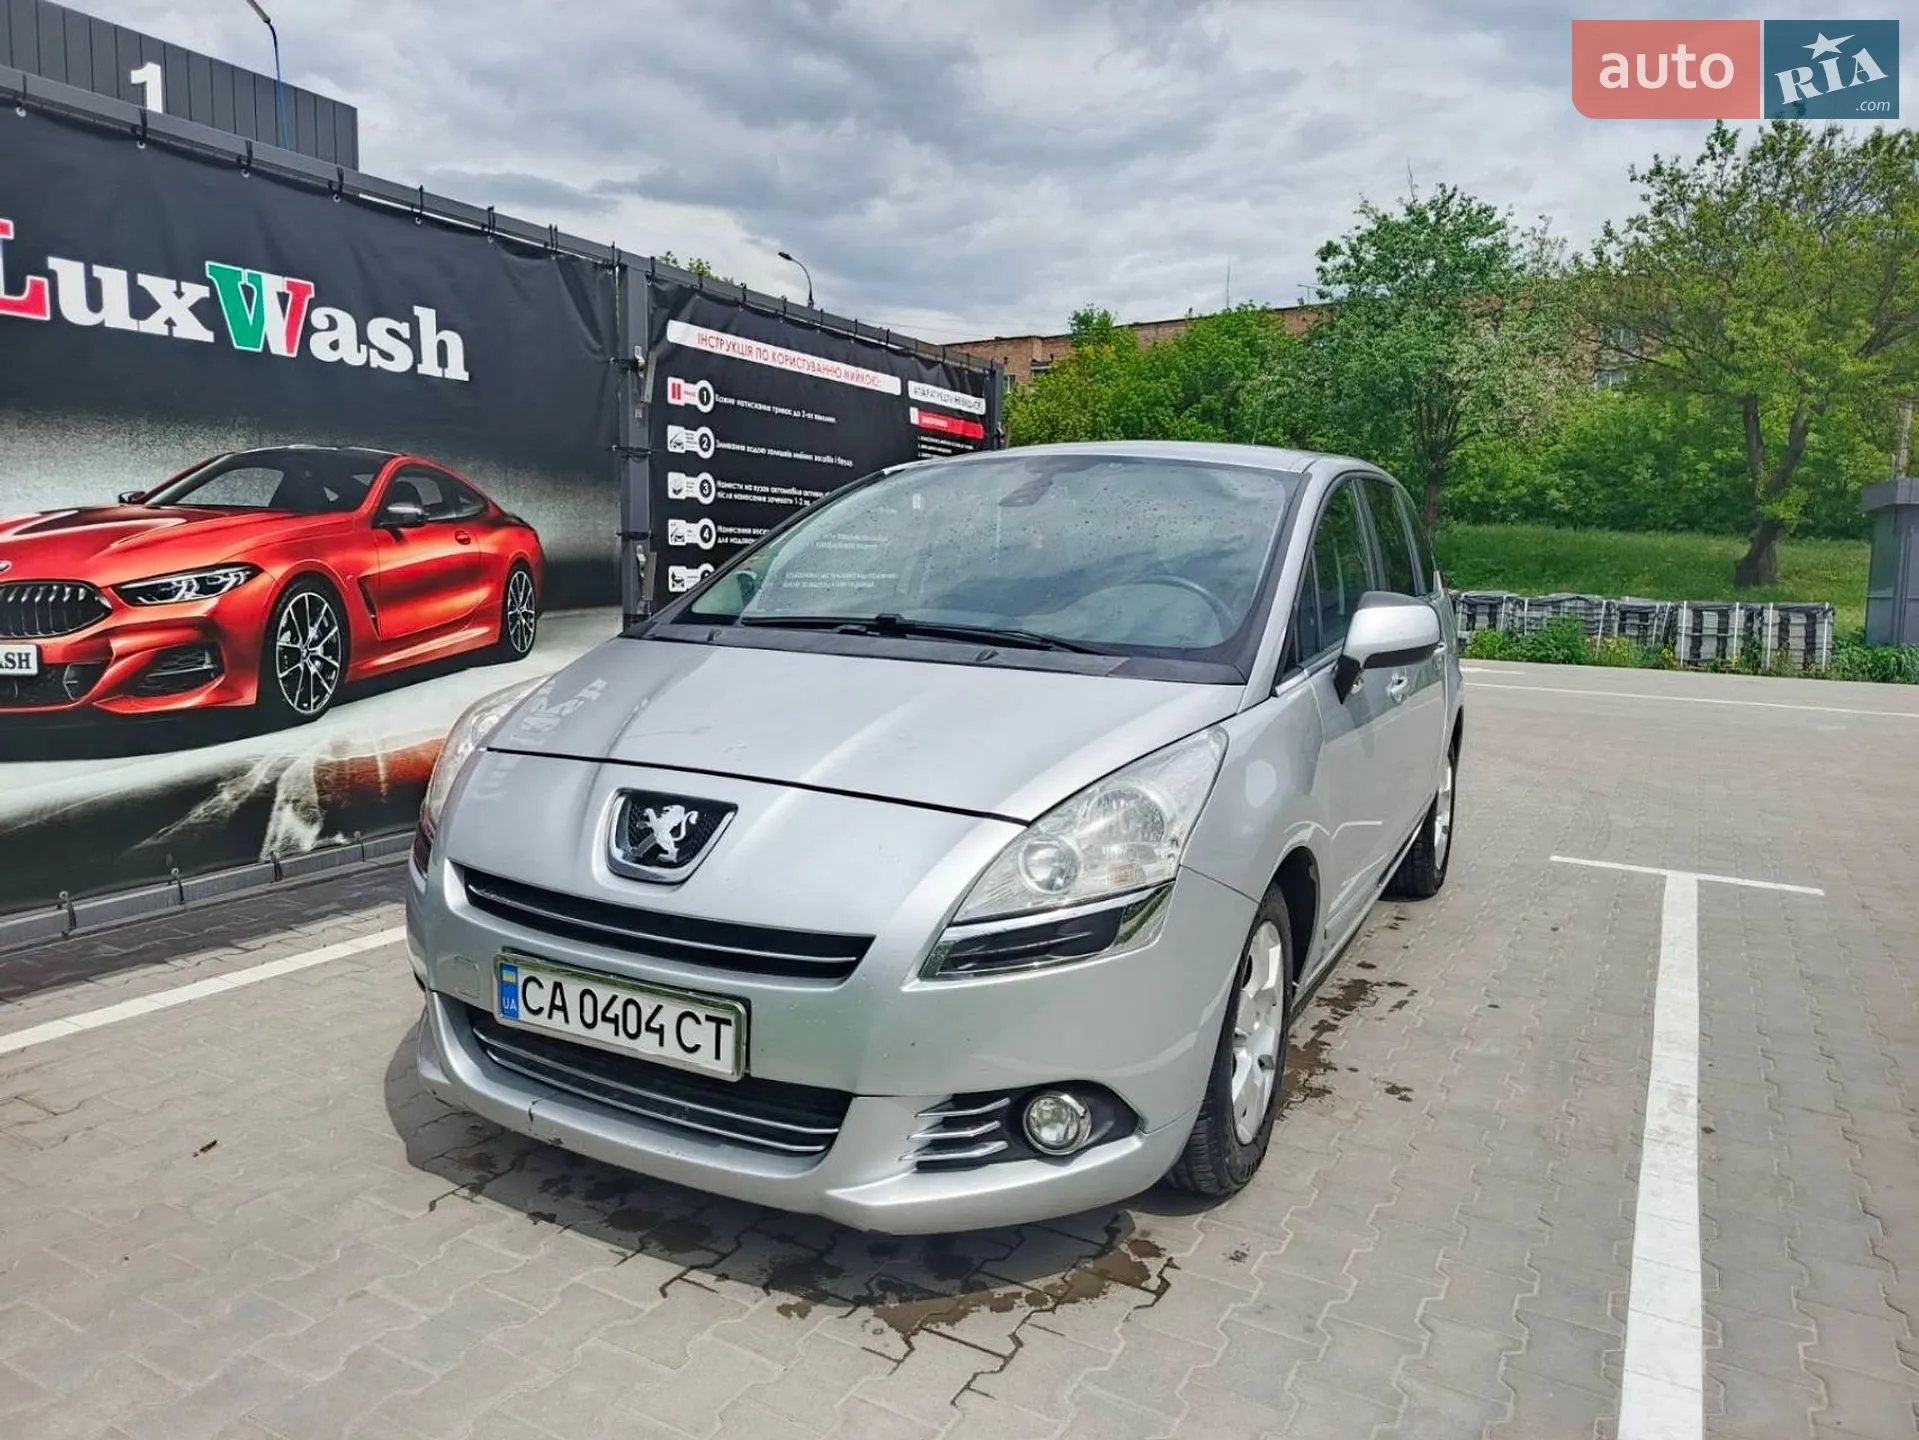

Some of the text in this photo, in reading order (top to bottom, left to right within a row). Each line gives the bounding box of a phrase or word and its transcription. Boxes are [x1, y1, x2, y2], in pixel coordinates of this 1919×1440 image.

[130, 61, 163, 113] 1
[697, 332, 753, 359] ІНСТРУКЦІЯ
[755, 347, 770, 362] ПО
[771, 350, 842, 378] КОРИСТУВАННЮ
[703, 391, 707, 402] 1
[703, 437, 708, 448] 2
[703, 483, 708, 494] 3
[703, 528, 708, 540] 4
[0, 652, 31, 669] SH
[502, 997, 517, 1012] UA
[521, 975, 733, 1061] CA 0404 CT
